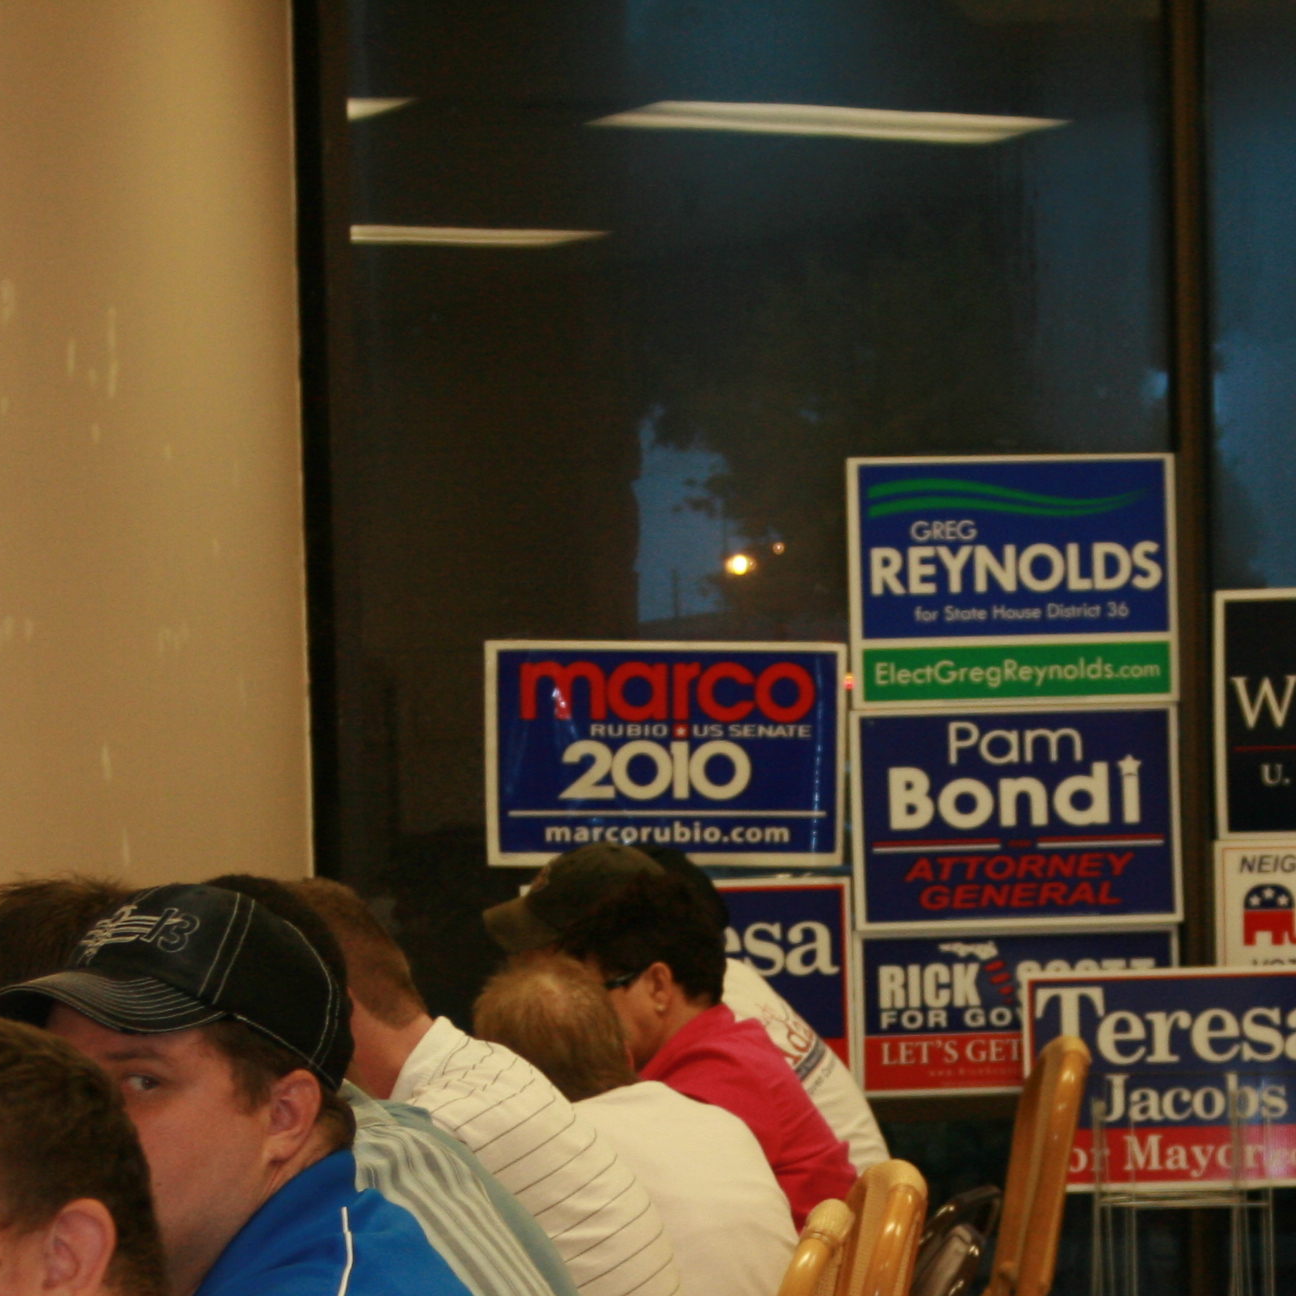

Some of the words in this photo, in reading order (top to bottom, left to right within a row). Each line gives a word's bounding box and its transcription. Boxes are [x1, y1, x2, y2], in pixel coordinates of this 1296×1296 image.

[911, 520, 977, 542] GREG
[870, 541, 1162, 598] REYNOLDS
[914, 607, 938, 622] for
[945, 605, 987, 622] State
[993, 604, 1041, 620] House
[1047, 602, 1101, 619] District
[1108, 602, 1129, 617] 36
[875, 657, 1161, 688] ElectGregReynolds.com
[519, 661, 816, 722] marco
[590, 724, 668, 738] RUBIO
[693, 724, 723, 738] US
[729, 724, 812, 738] SENATE
[948, 722, 1083, 765] Pam
[558, 740, 752, 800] 2010
[889, 755, 1142, 830] Bondi
[545, 821, 790, 844] marcorubio.com
[905, 852, 1135, 883] ATTORNEY
[919, 881, 1122, 911] GENERAL
[879, 962, 982, 1010] RICK
[880, 1009, 948, 1029] FOR
[964, 1007, 1022, 1028] GO
[882, 1040, 958, 1065] LET'S
[966, 1038, 1023, 1064] GET
[1103, 1070, 1289, 1123] Jacobs
